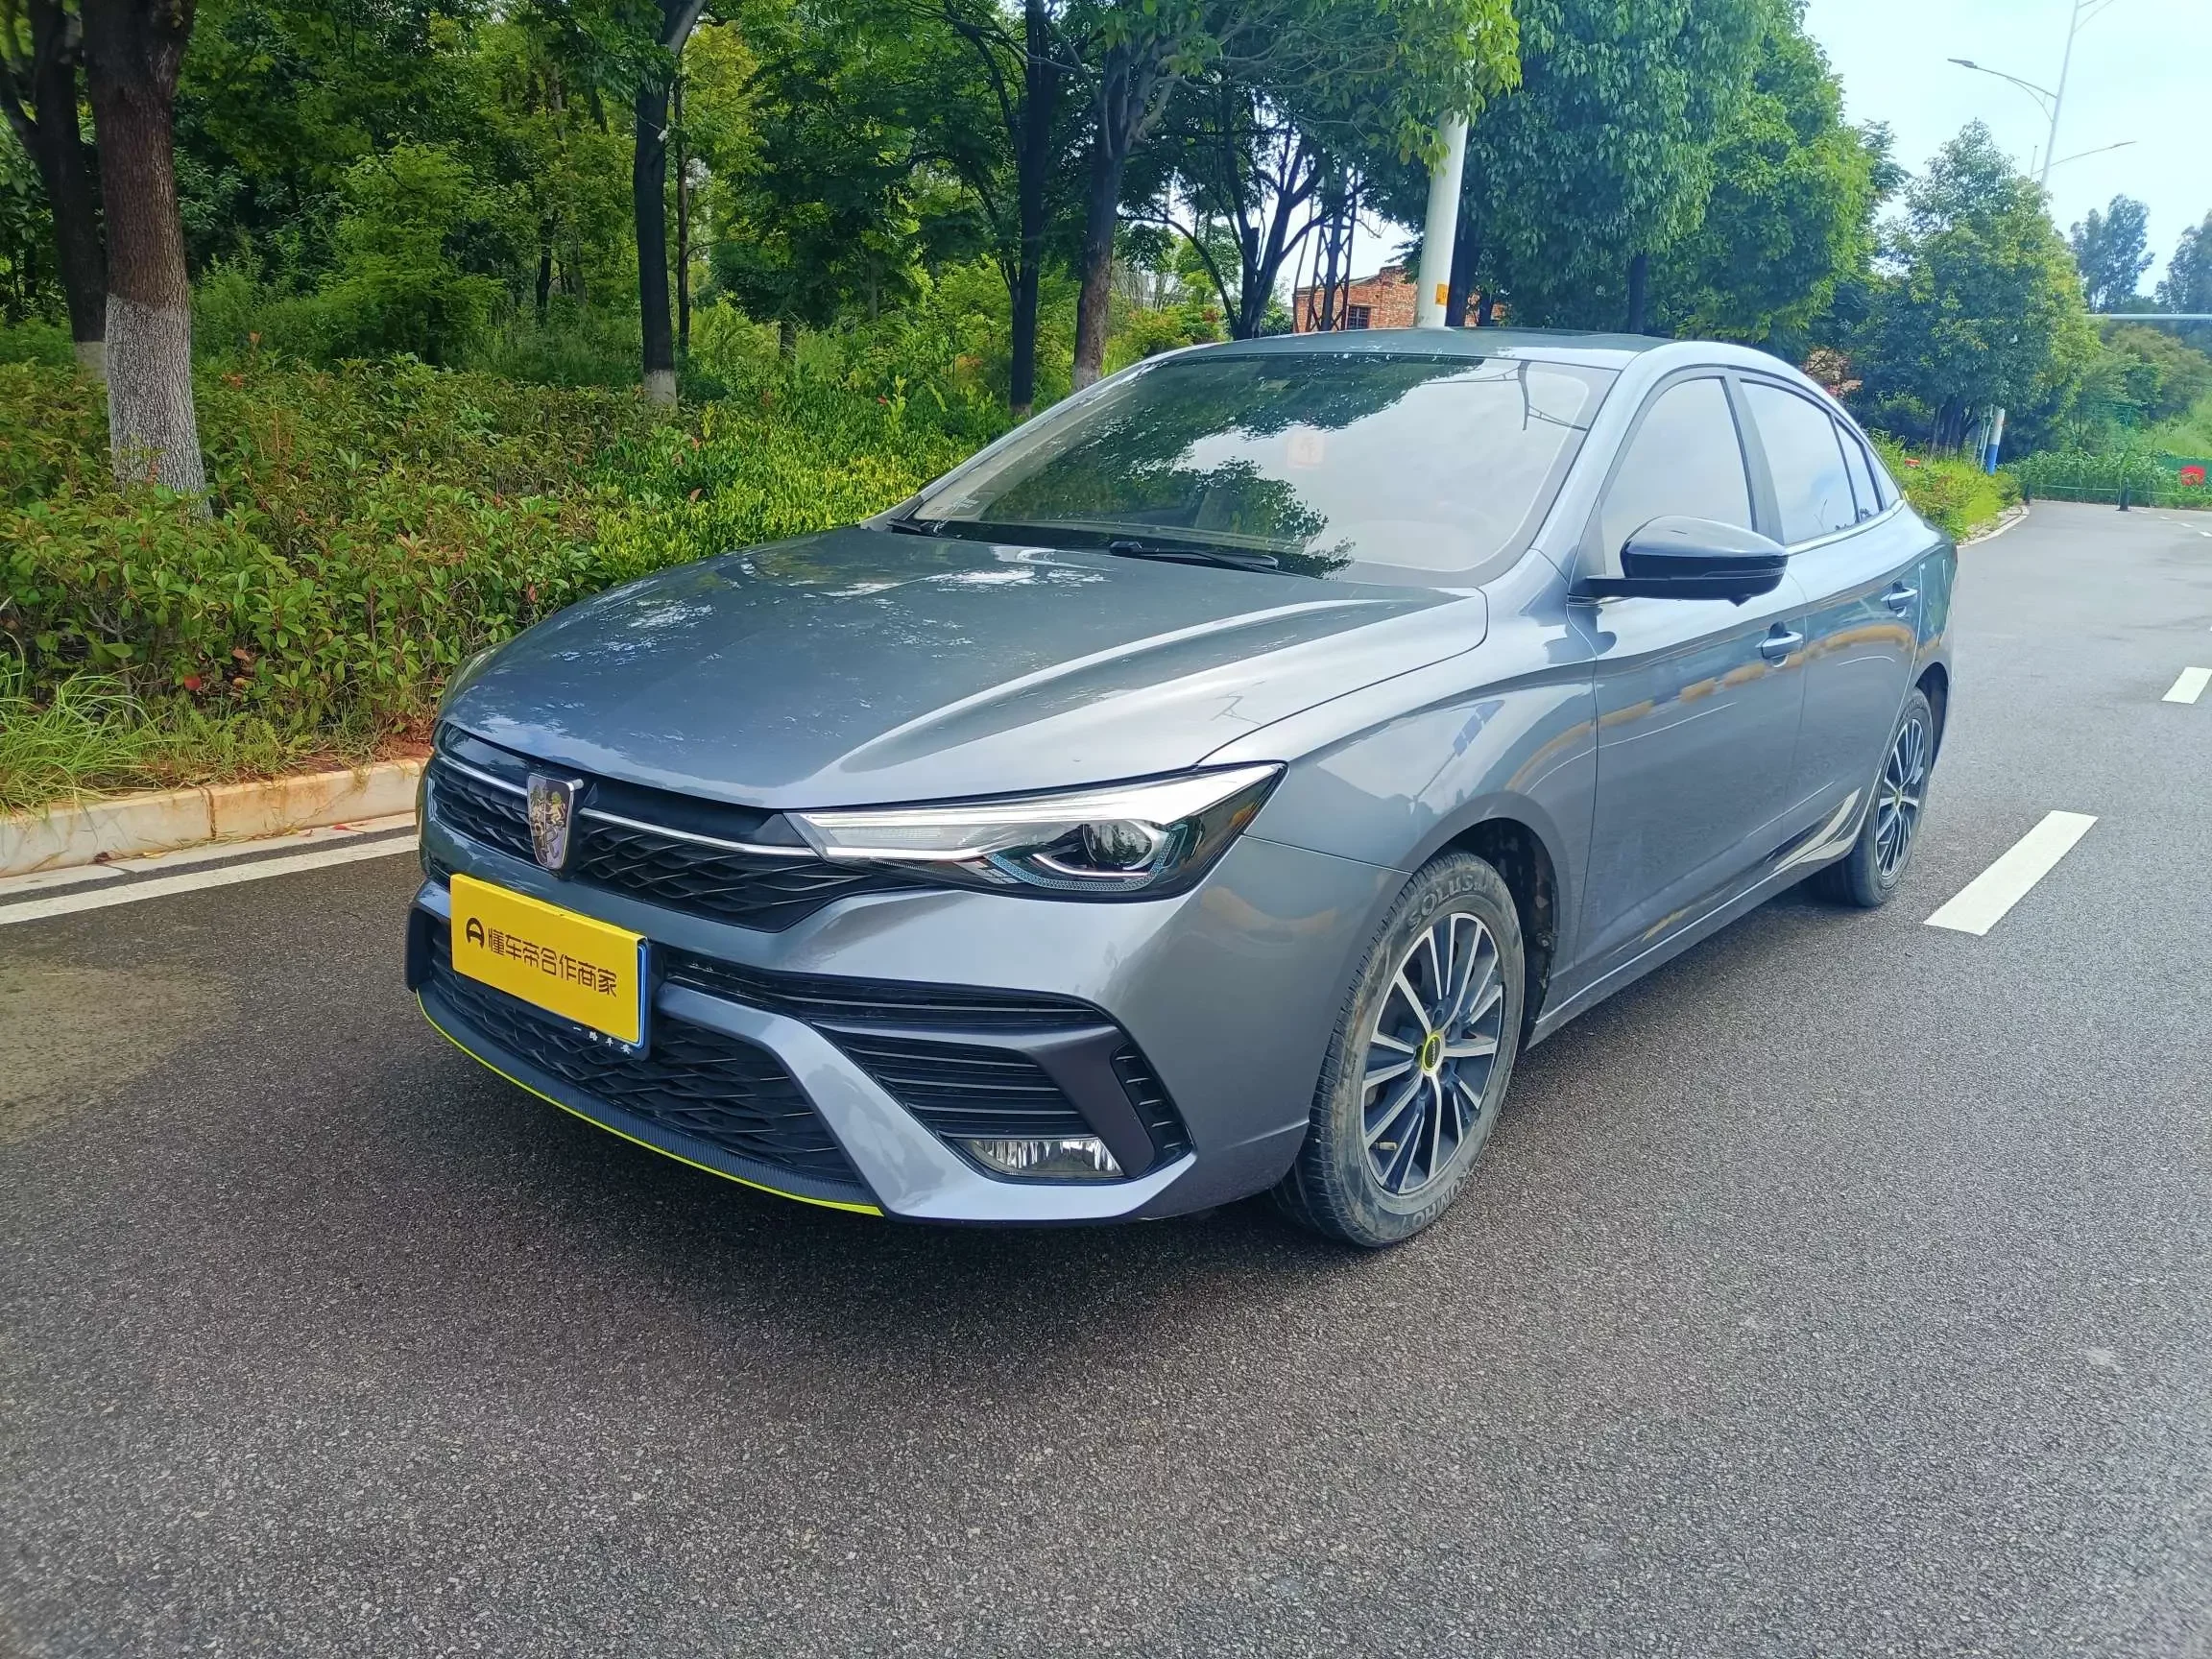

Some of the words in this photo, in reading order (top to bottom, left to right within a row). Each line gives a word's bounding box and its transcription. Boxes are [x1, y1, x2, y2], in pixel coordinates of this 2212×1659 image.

[1407, 875, 1473, 931] SOLUS
[488, 926, 617, 998] 懂车帝合作商家
